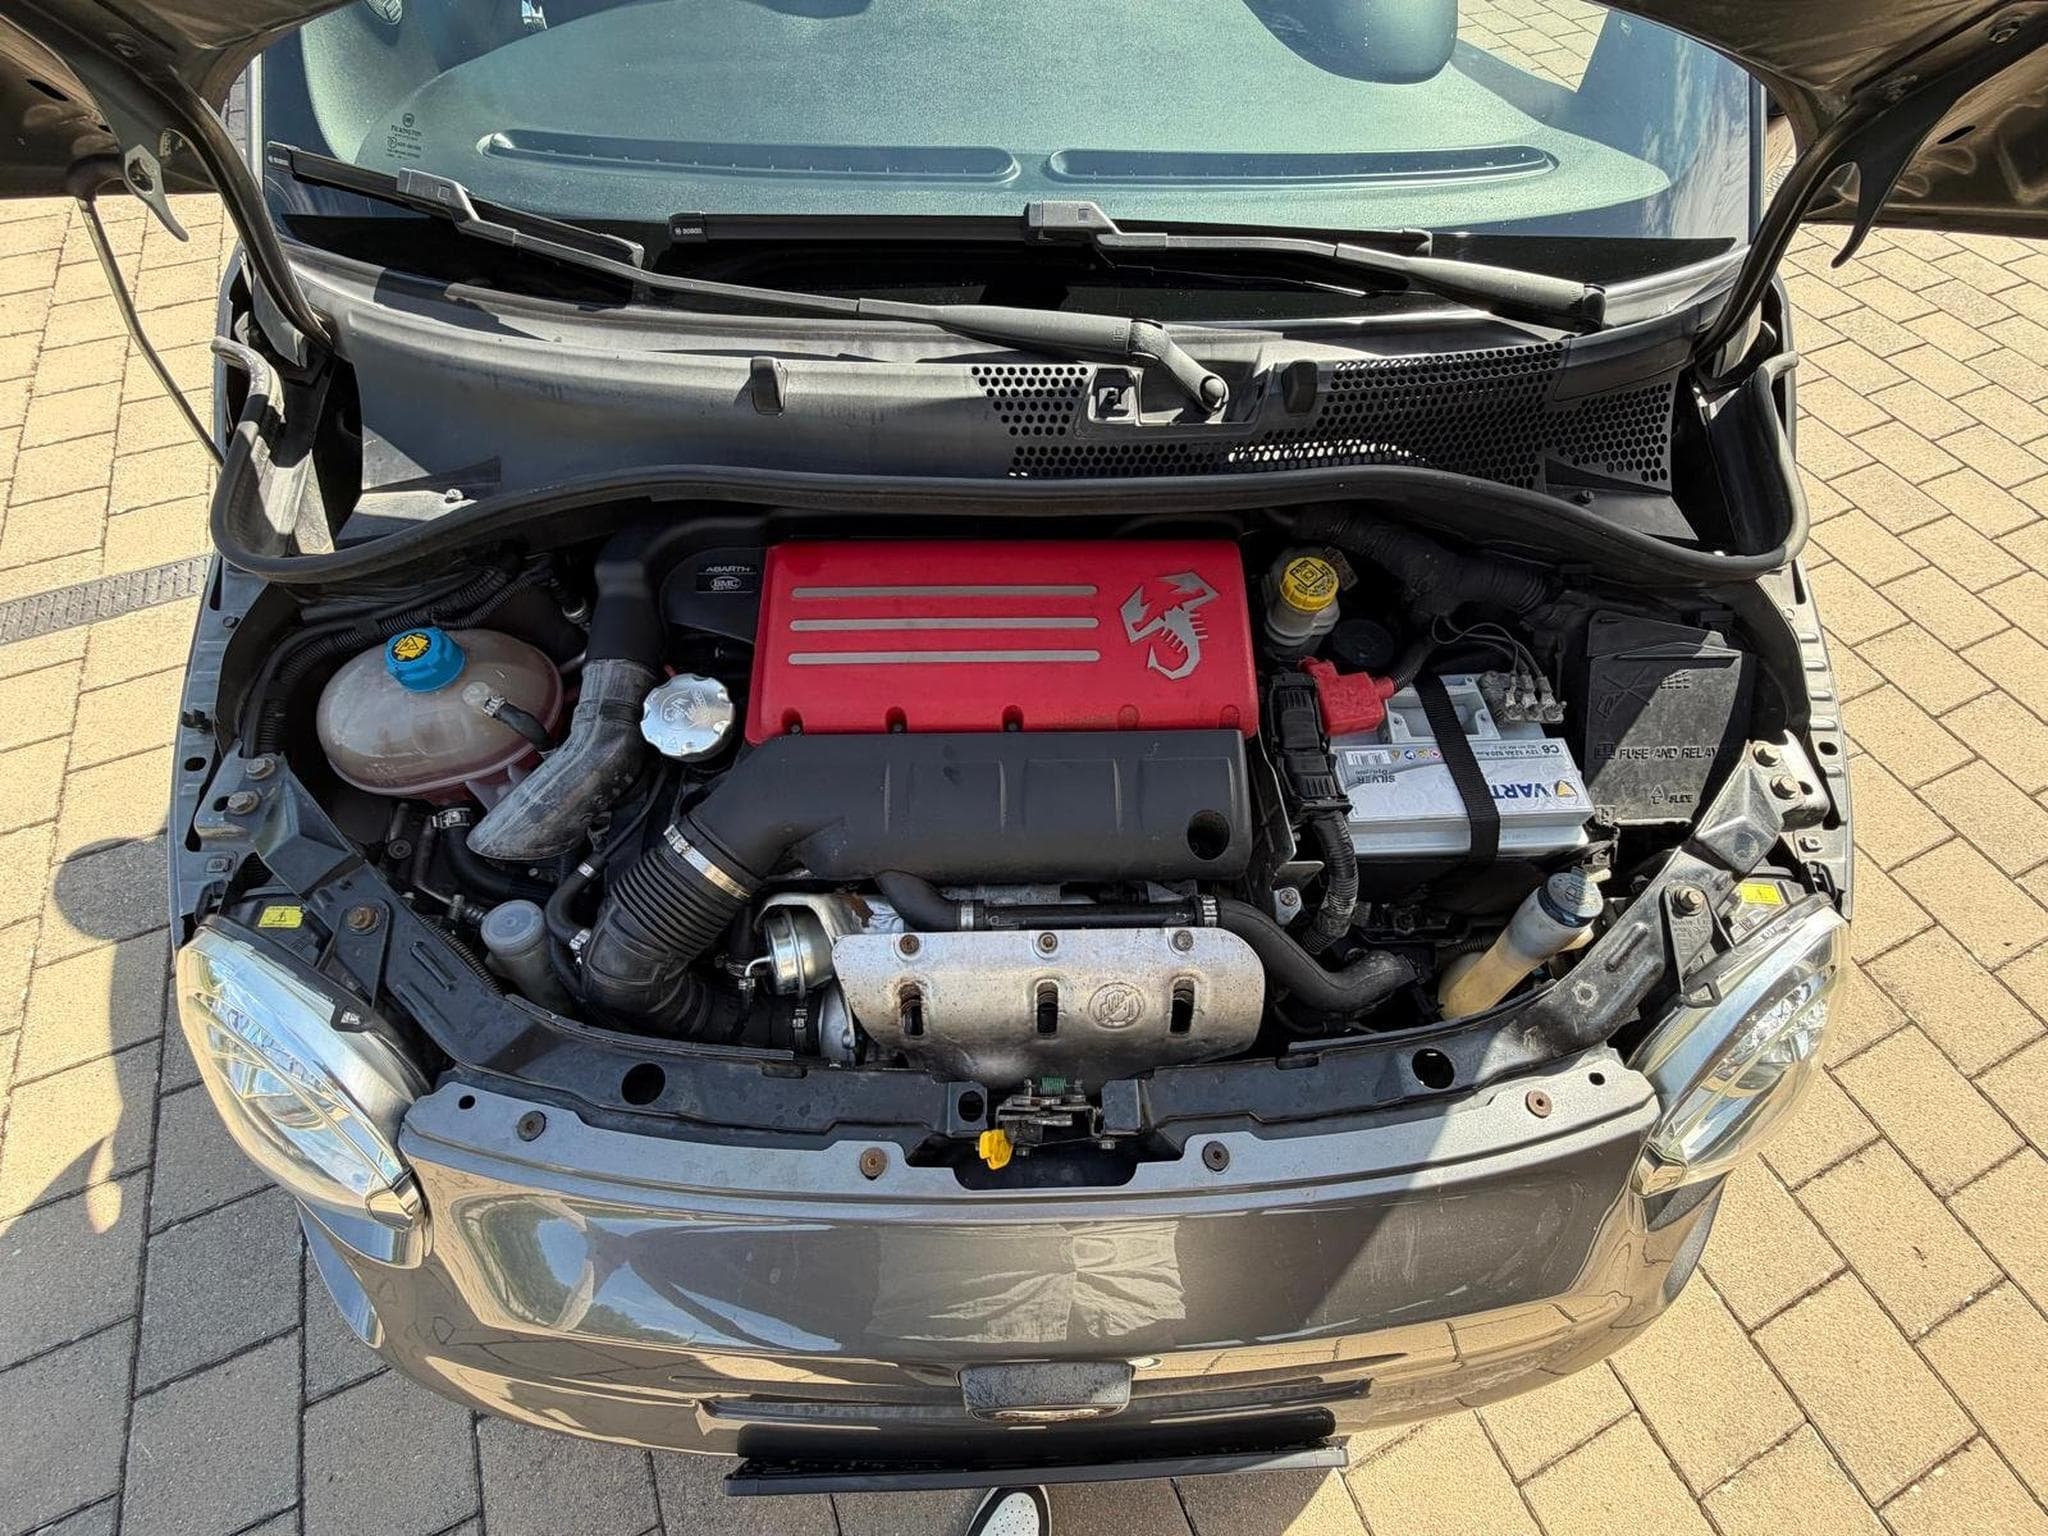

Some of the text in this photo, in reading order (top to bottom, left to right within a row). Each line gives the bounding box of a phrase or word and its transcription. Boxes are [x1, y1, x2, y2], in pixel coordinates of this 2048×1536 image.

[706, 565, 750, 573] ABARTH
[1541, 744, 1560, 754] C6
[1619, 746, 1717, 760] FUSE AND RELAY
[1356, 775, 1396, 784] SILVER
[1491, 783, 1552, 800] VART
